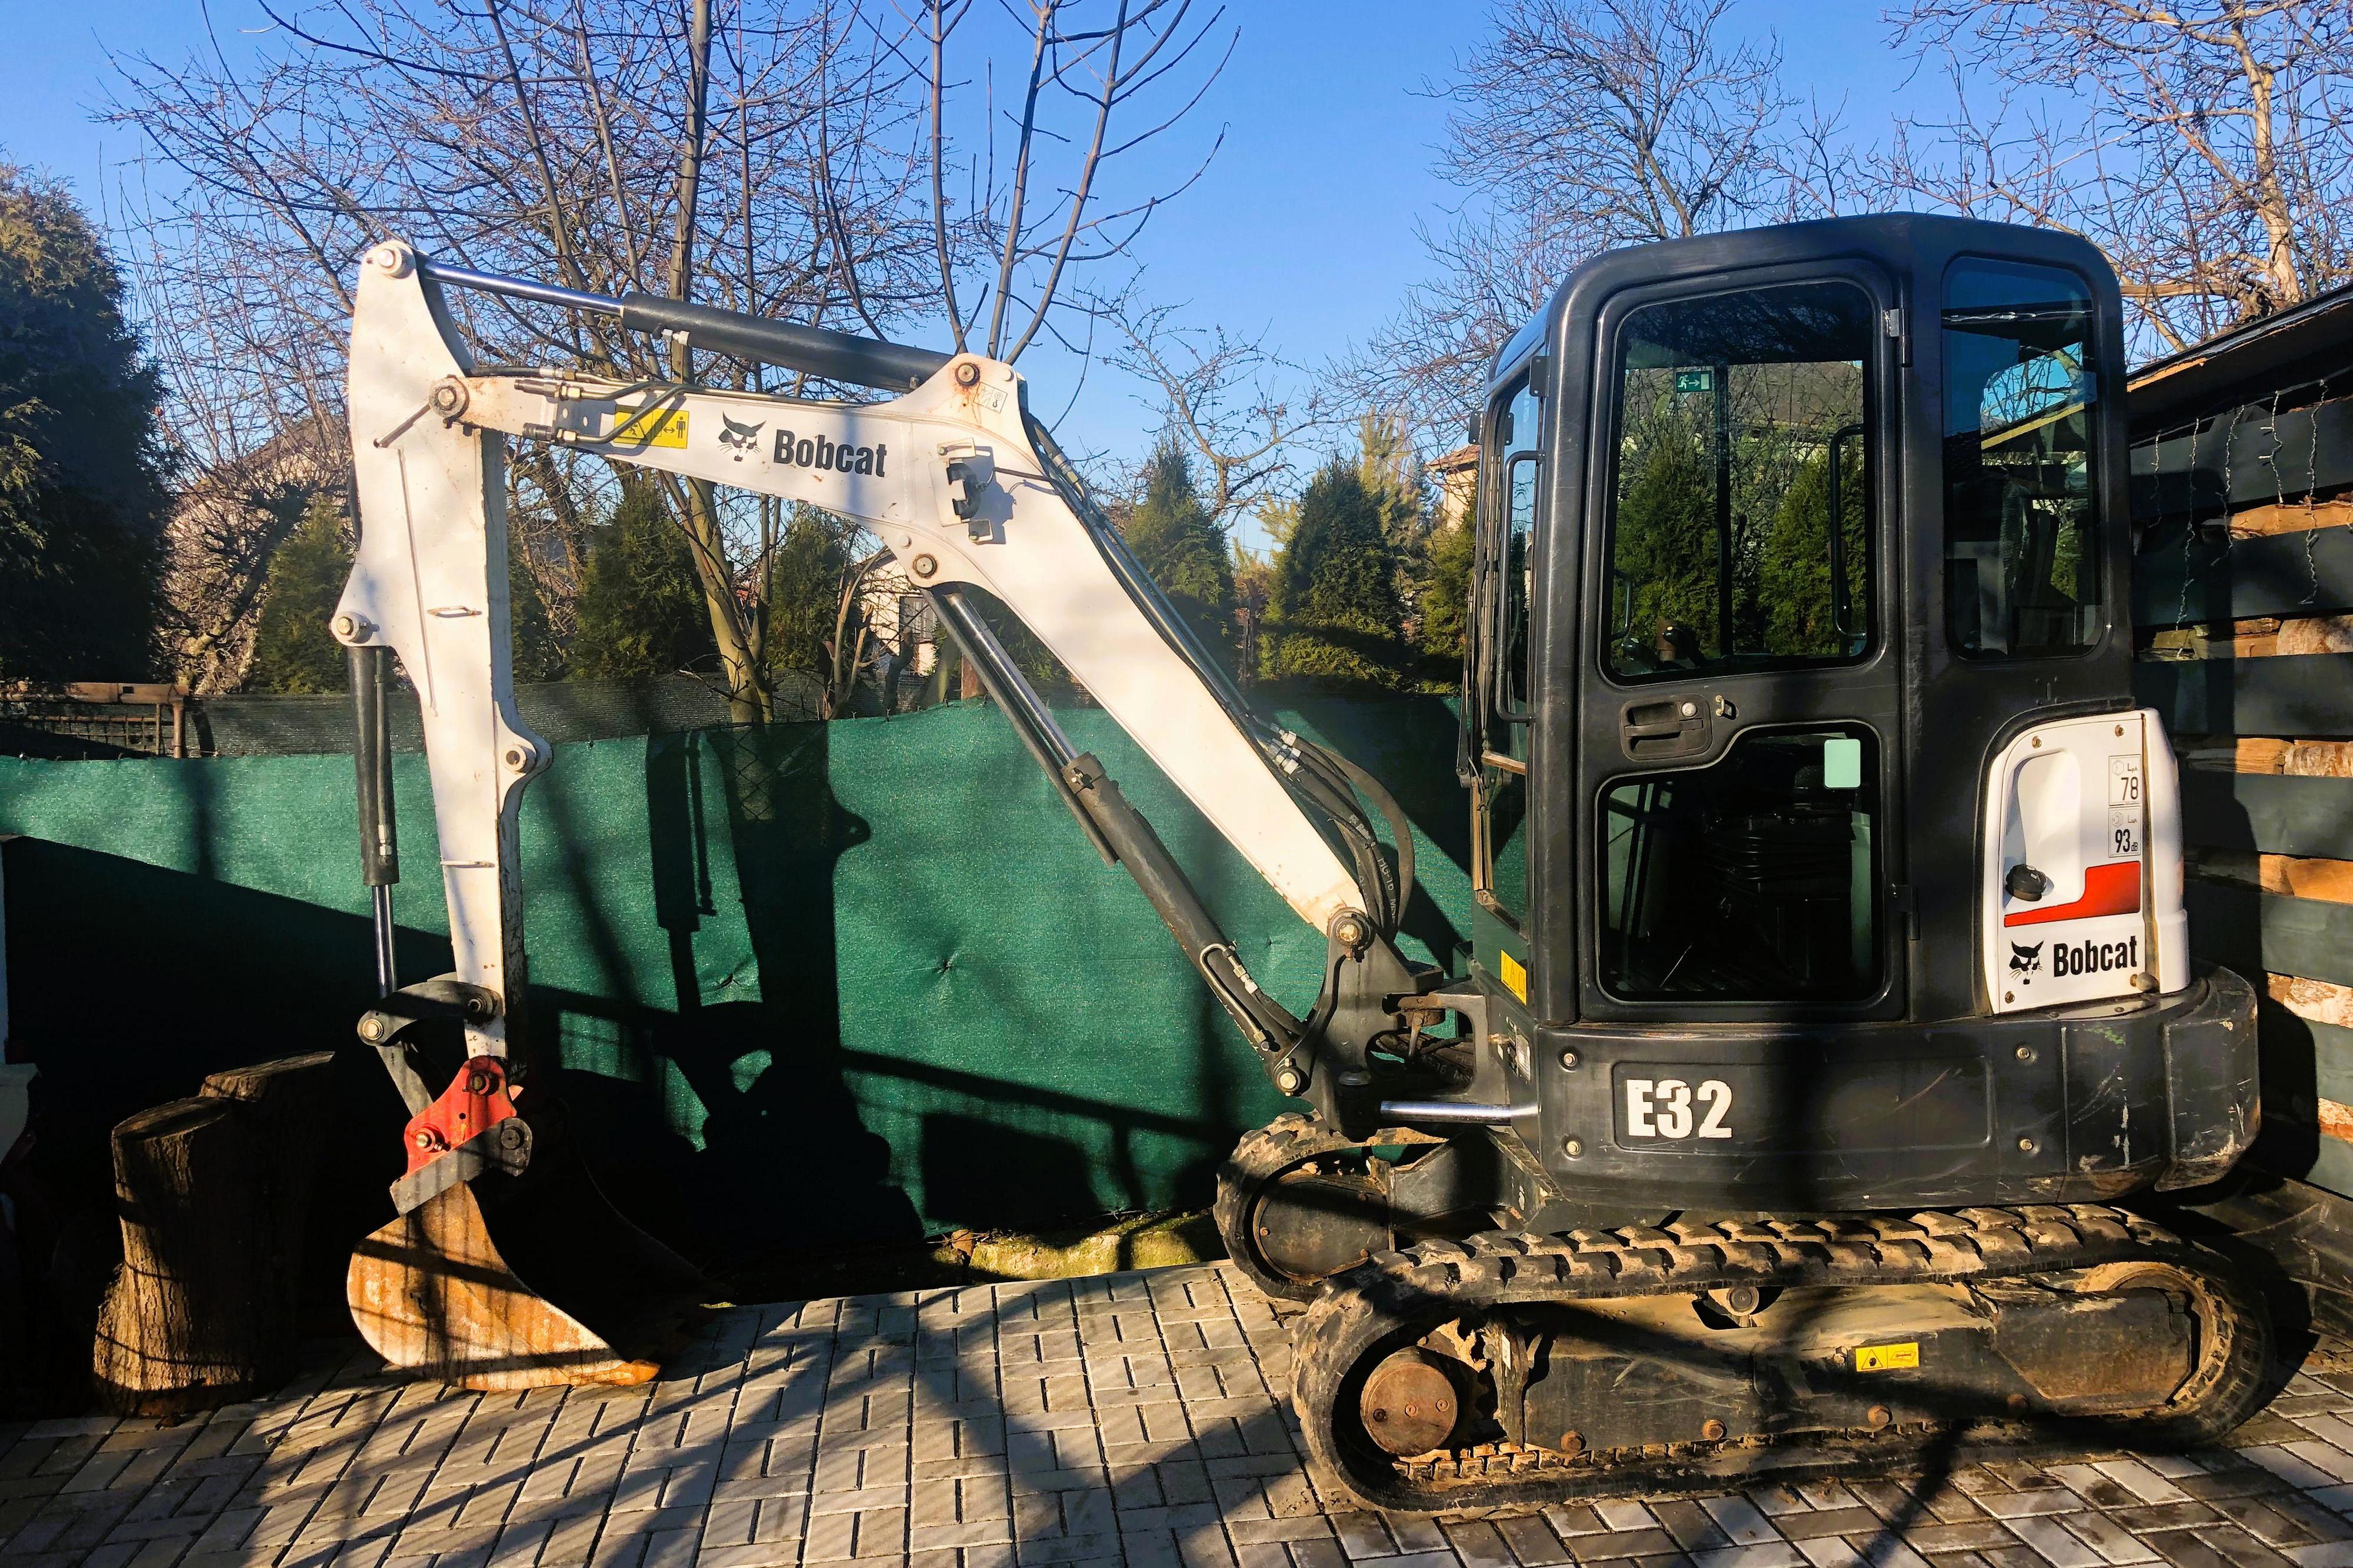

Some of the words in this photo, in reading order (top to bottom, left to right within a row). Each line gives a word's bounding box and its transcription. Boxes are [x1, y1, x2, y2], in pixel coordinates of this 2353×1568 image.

[774, 429, 888, 478] Bobcat
[2121, 776, 2138, 800] 78
[2115, 829, 2131, 853] 93
[2054, 935, 2137, 978] Bobcat
[1627, 1079, 1733, 1139] E32
